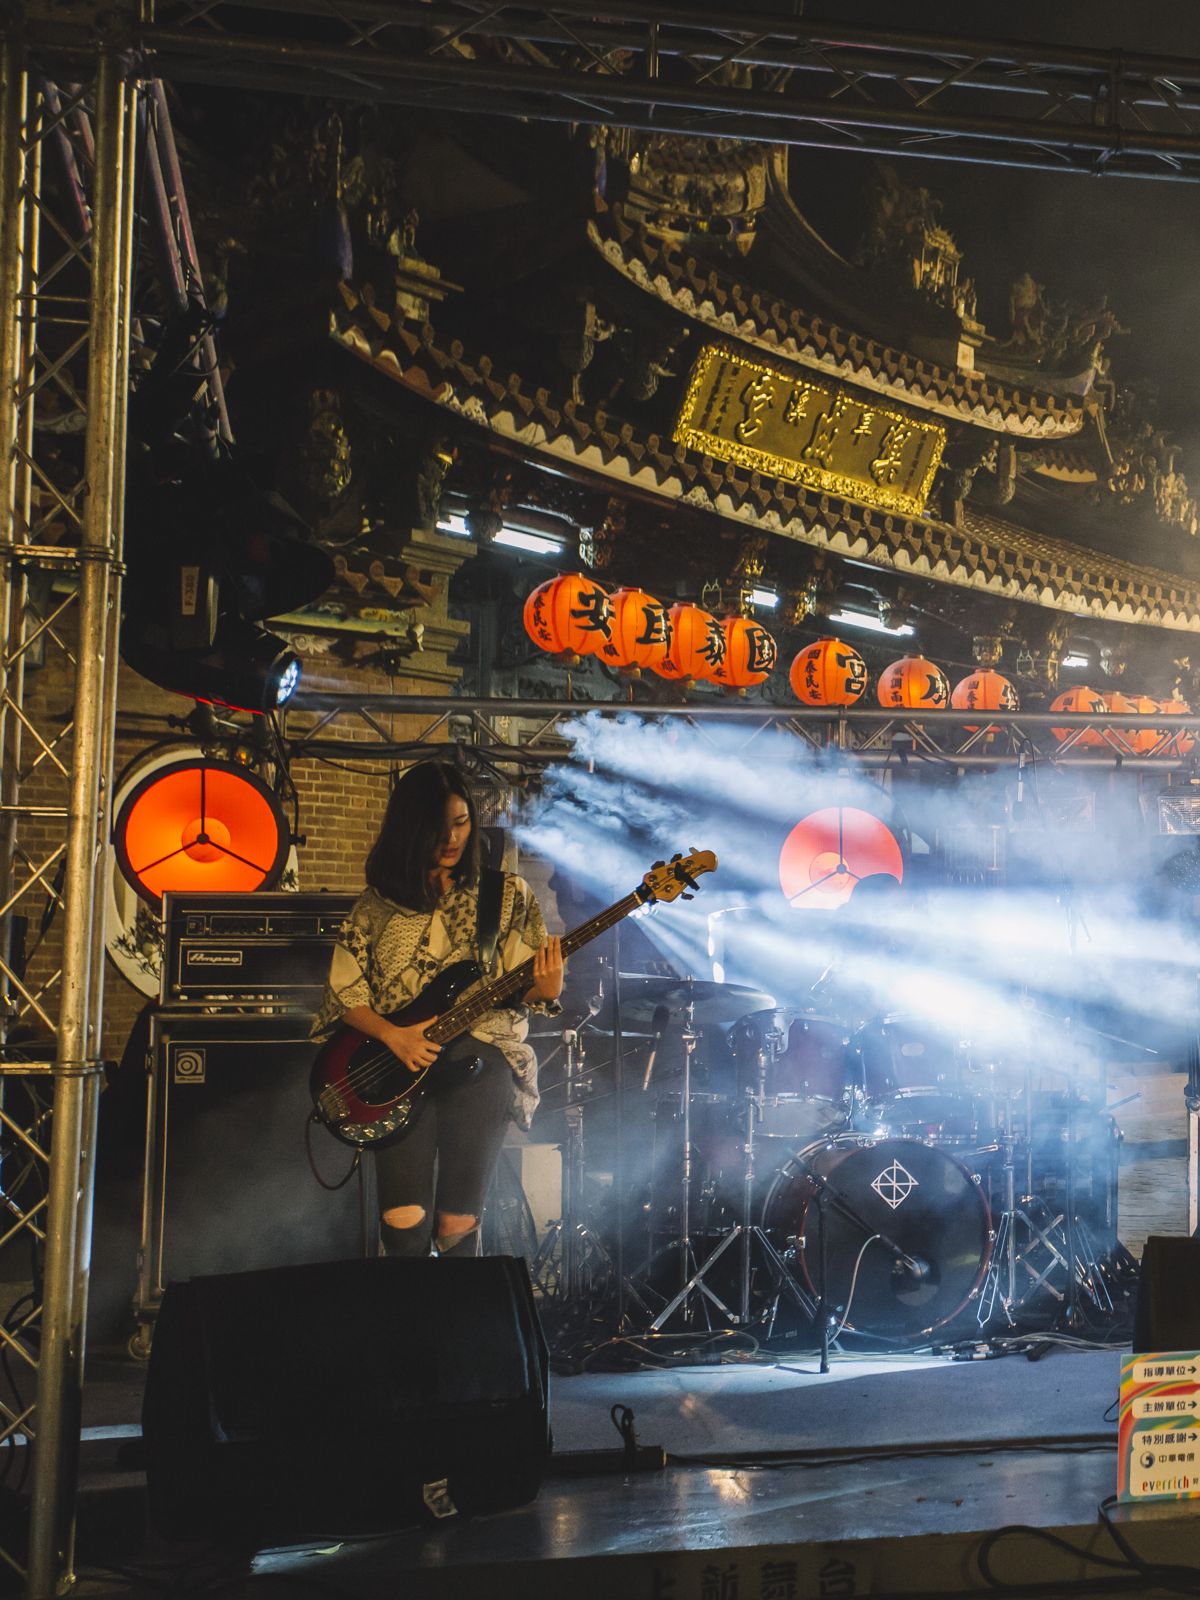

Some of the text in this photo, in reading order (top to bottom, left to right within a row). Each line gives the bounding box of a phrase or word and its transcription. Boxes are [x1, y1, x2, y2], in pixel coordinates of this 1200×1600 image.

[1143, 1363, 1187, 1379] 指導單位
[1142, 1399, 1187, 1414] 主辦單位
[1141, 1432, 1188, 1446] 特別感謝
[1142, 1475, 1190, 1492] everrich
